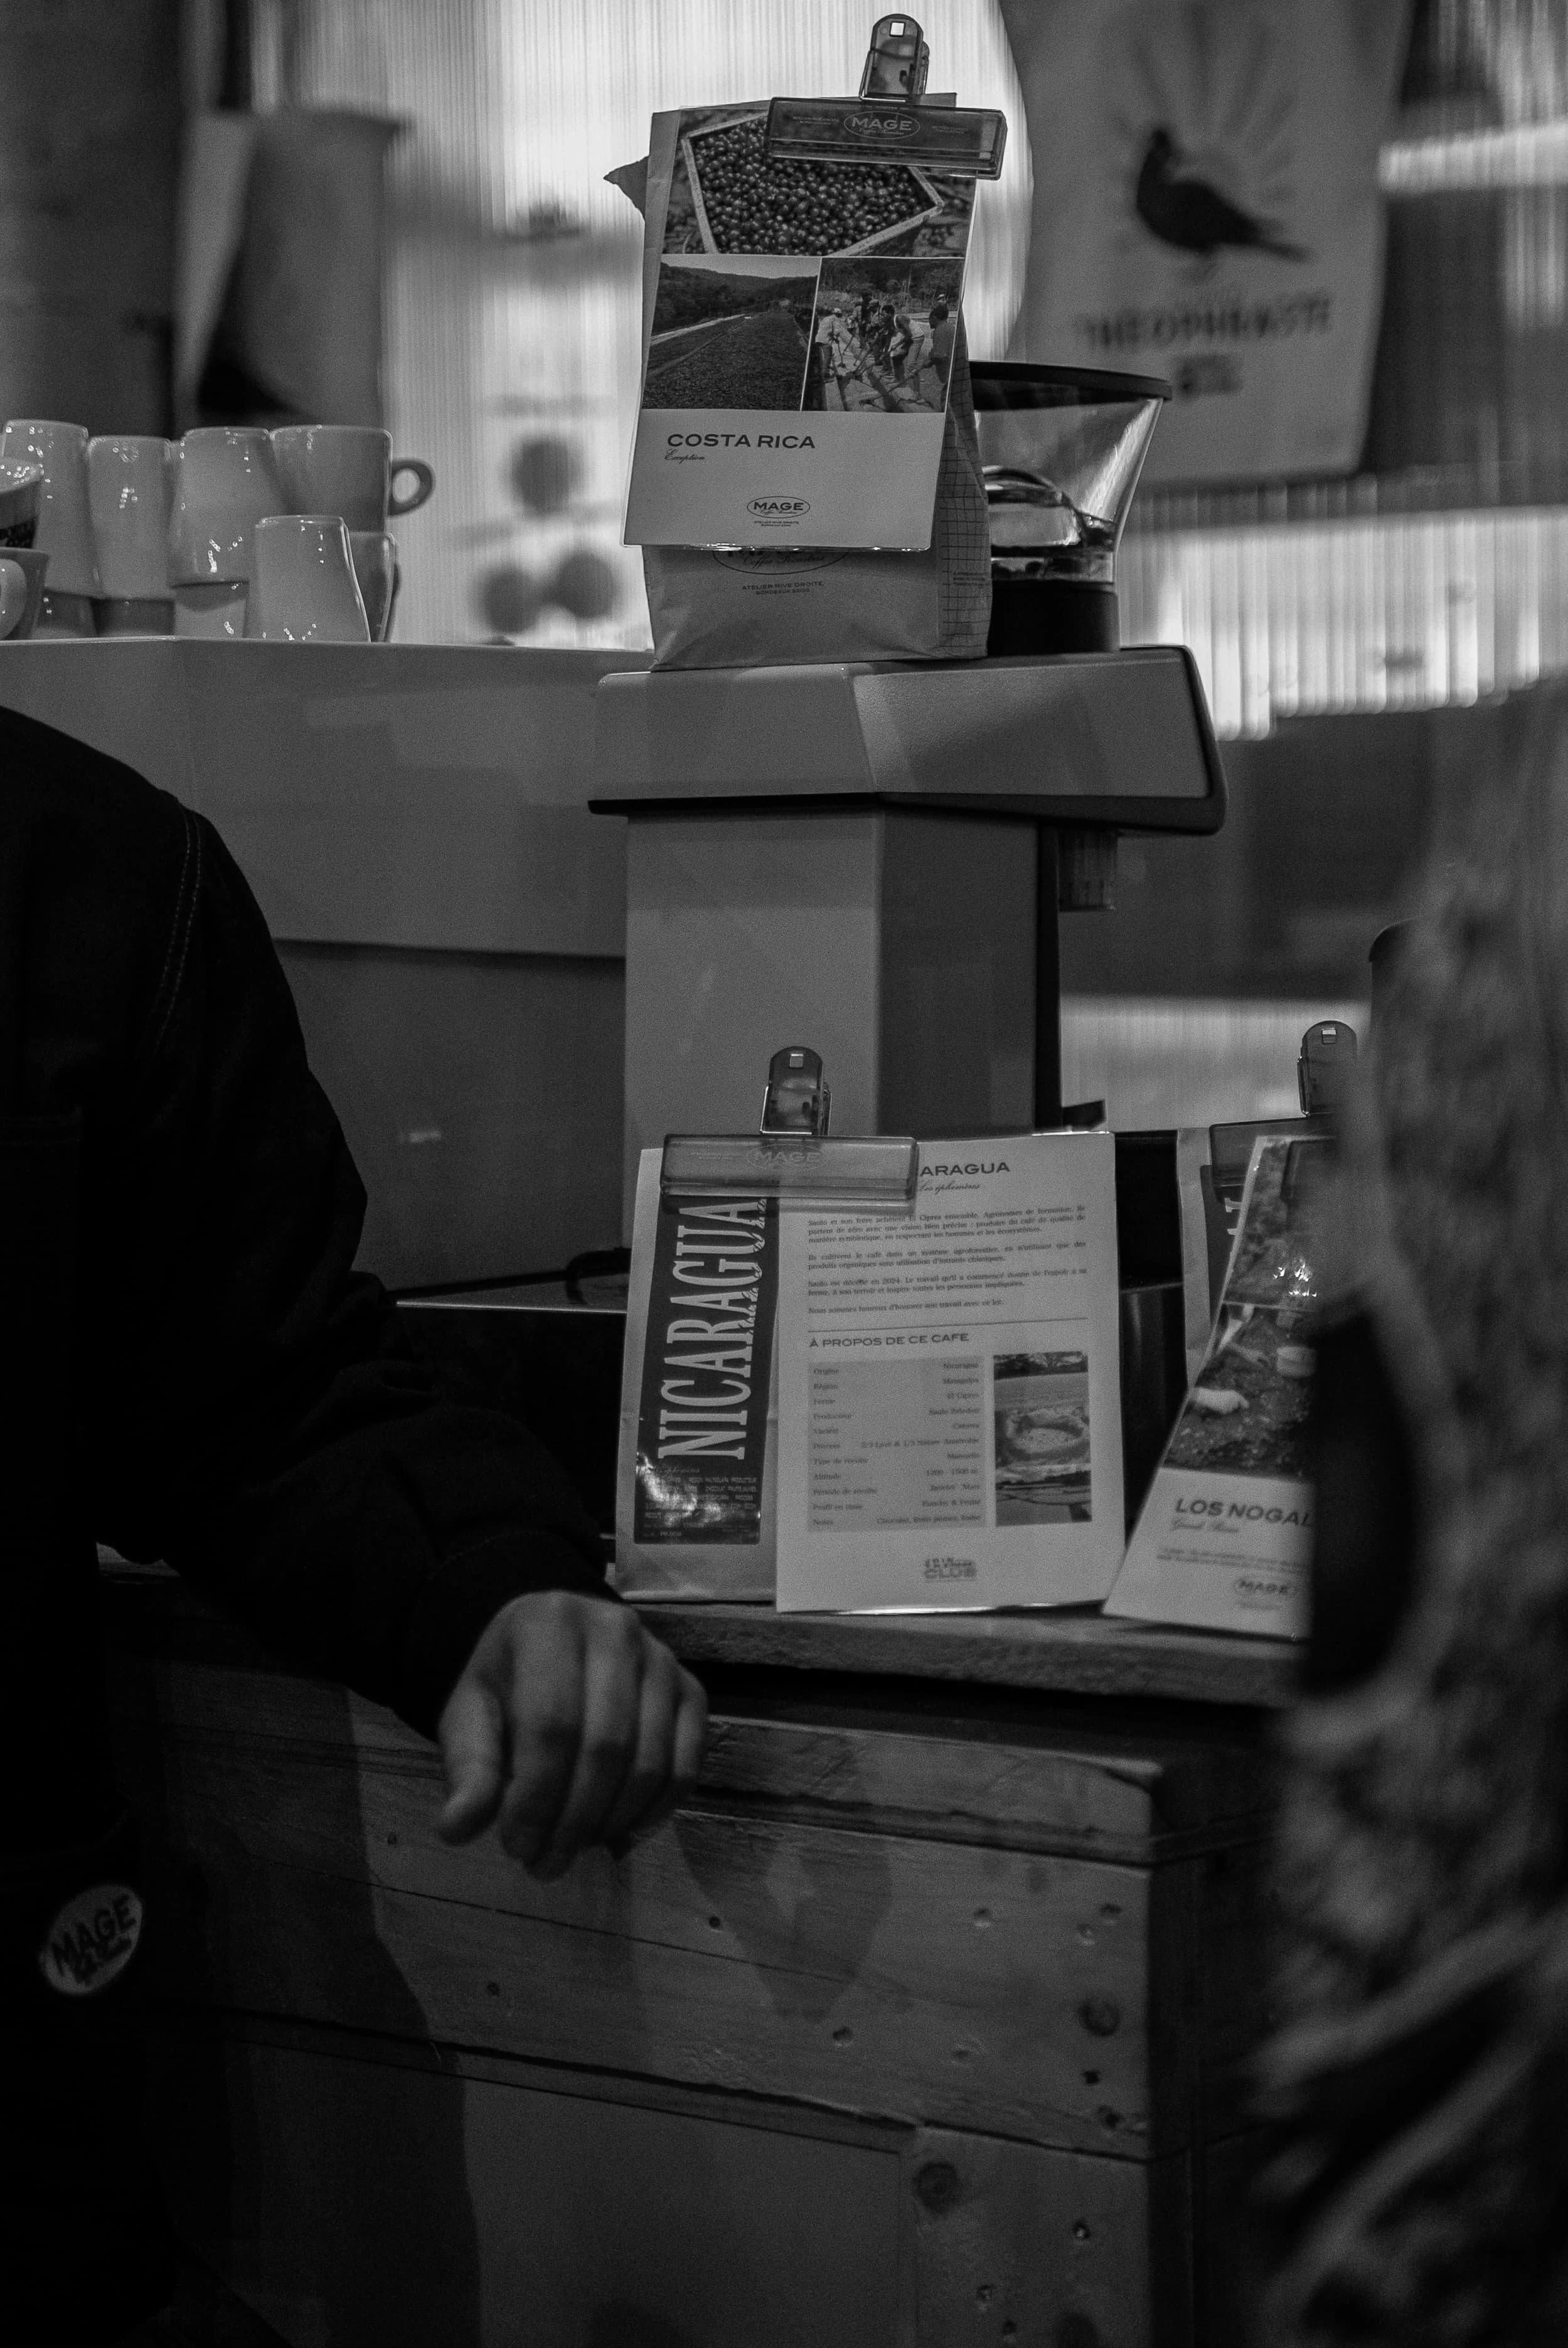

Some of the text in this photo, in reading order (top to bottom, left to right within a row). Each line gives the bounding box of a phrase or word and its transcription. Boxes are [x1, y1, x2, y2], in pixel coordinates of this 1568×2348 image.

[851, 117, 912, 131] MAGE
[668, 434, 816, 449] COSTA RICA
[664, 449, 705, 463] Exception
[753, 501, 804, 511] MAGE
[743, 556, 773, 569] Coffee
[777, 554, 824, 564] Roasters
[754, 1151, 821, 1163] MAGE
[920, 1162, 1010, 1177] ARAGUA
[659, 1200, 767, 1461] NICARAGUA
[822, 1337, 882, 1348] PROPOS
[886, 1336, 905, 1346] DE
[908, 1335, 928, 1344] CE
[1175, 1498, 1224, 1517] LOS
[1229, 1503, 1313, 1527] NOGAL
[50, 1894, 136, 1976] MAGE
